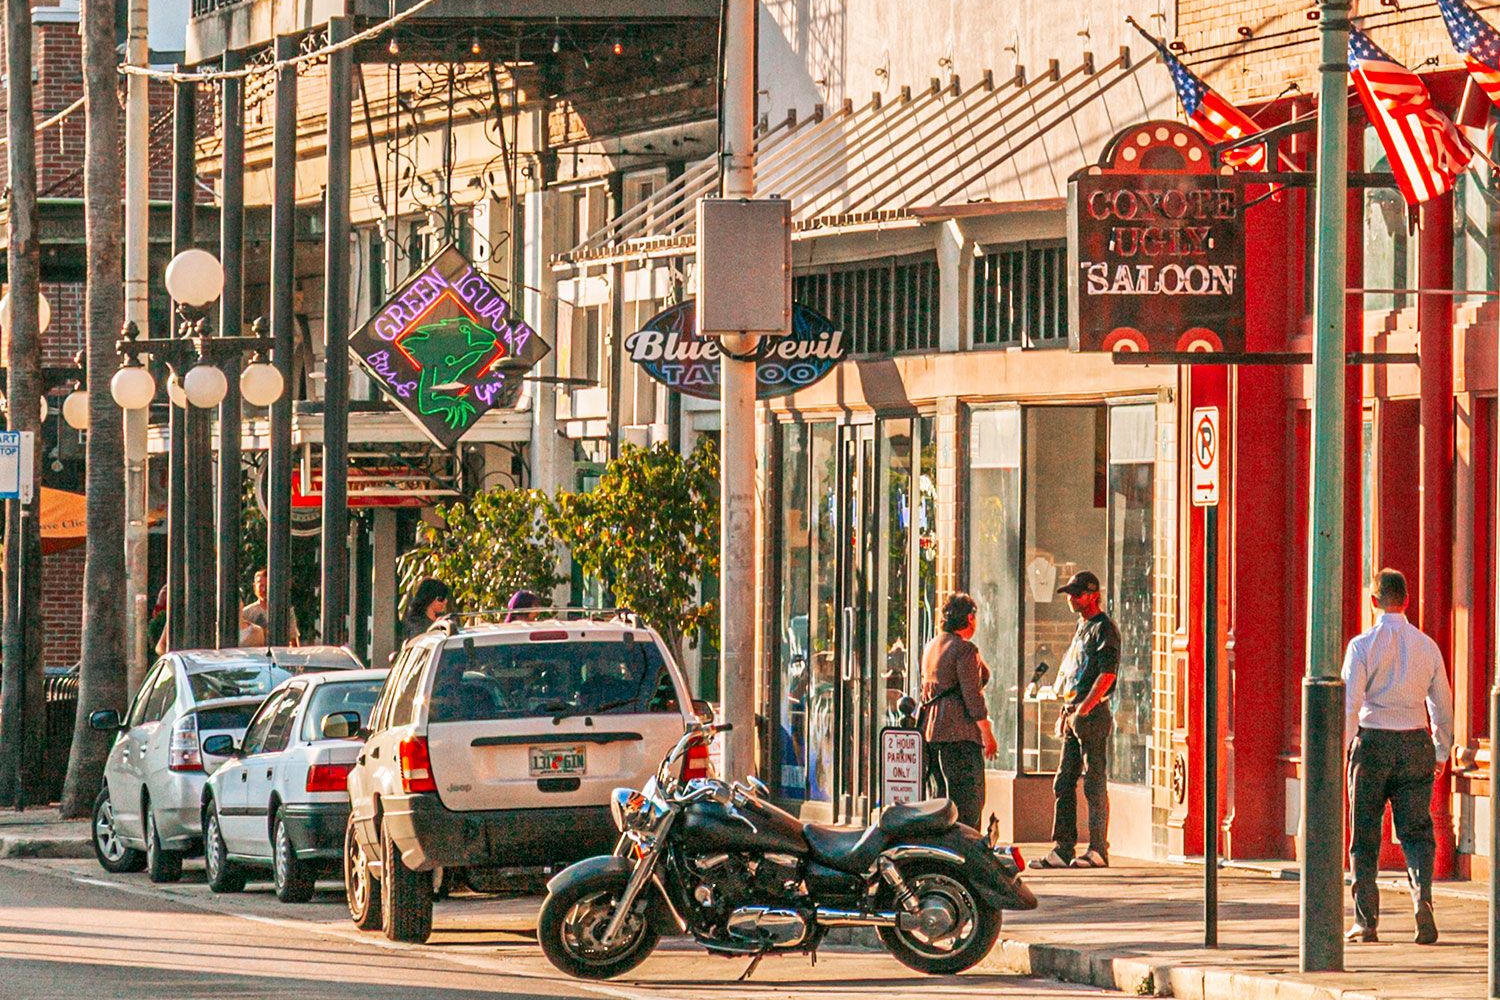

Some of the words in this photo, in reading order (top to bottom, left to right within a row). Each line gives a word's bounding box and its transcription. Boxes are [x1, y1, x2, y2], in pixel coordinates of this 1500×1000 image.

[1087, 188, 1237, 221] COYOTE
[1115, 226, 1212, 257] UGLY
[1086, 262, 1237, 296] SALOON
[375, 267, 449, 341] GREEN
[625, 330, 721, 361] Blue
[763, 330, 845, 359] evil
[662, 363, 818, 385] TAOO
[888, 738, 894, 749] 2
[896, 738, 916, 750] HOUR
[887, 752, 917, 764] PARKING
[892, 766, 911, 778] ONLY
[446, 782, 472, 792] Jeep
